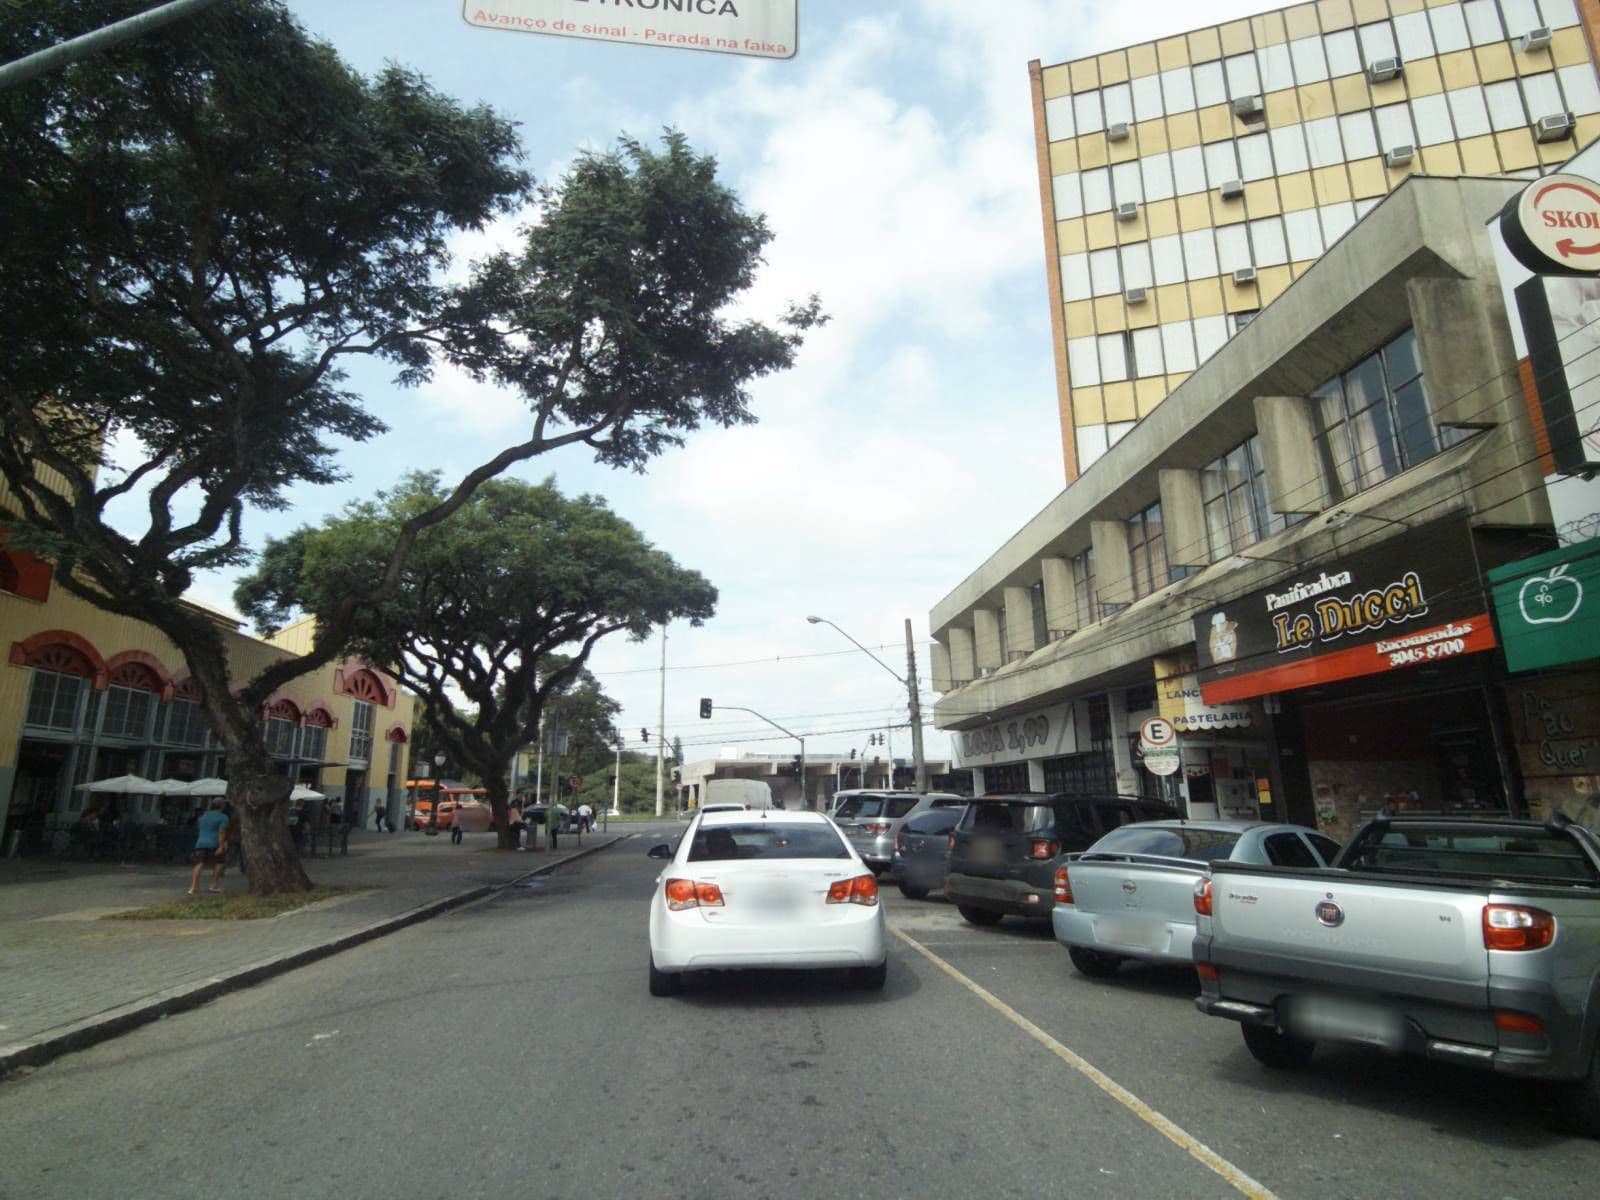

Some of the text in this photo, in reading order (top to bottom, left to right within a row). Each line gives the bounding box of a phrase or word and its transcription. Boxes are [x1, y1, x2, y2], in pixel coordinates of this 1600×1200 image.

[473, 9, 547, 29] Avanço
[552, 18, 576, 31] de
[582, 24, 627, 37] sinal
[644, 28, 711, 46] Parada
[715, 37, 739, 49] na
[743, 38, 788, 54] faixa
[1265, 571, 1352, 612] Panificadora
[1274, 573, 1427, 652] Le Ducci
[1376, 622, 1473, 654] Encomendas
[1389, 638, 1465, 666] 3045 8700
[1151, 723, 1164, 740] E
[1173, 712, 1253, 725] PASTELARIA
